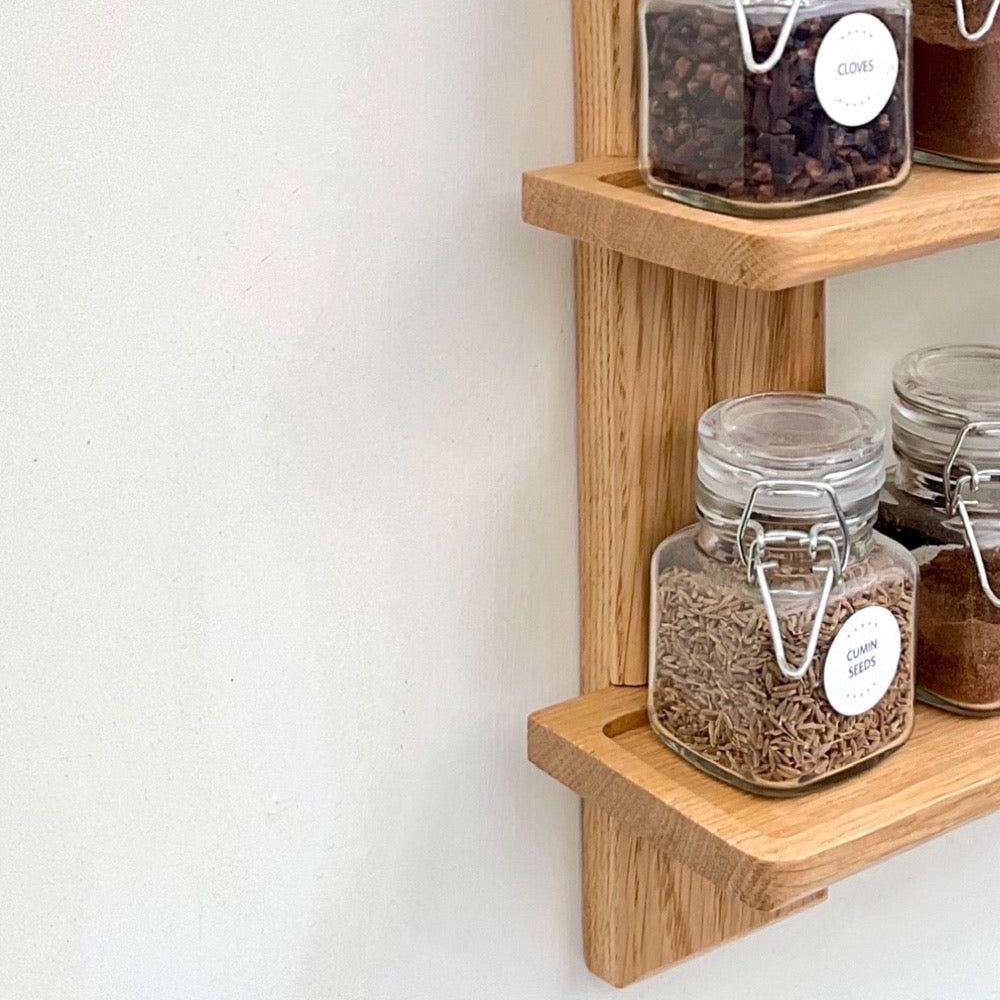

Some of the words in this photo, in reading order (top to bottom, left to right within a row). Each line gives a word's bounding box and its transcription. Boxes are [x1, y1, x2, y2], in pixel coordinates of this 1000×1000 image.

[838, 60, 873, 76] CLOVES
[846, 639, 877, 662] CUMIN
[849, 655, 876, 678] SEEDS
